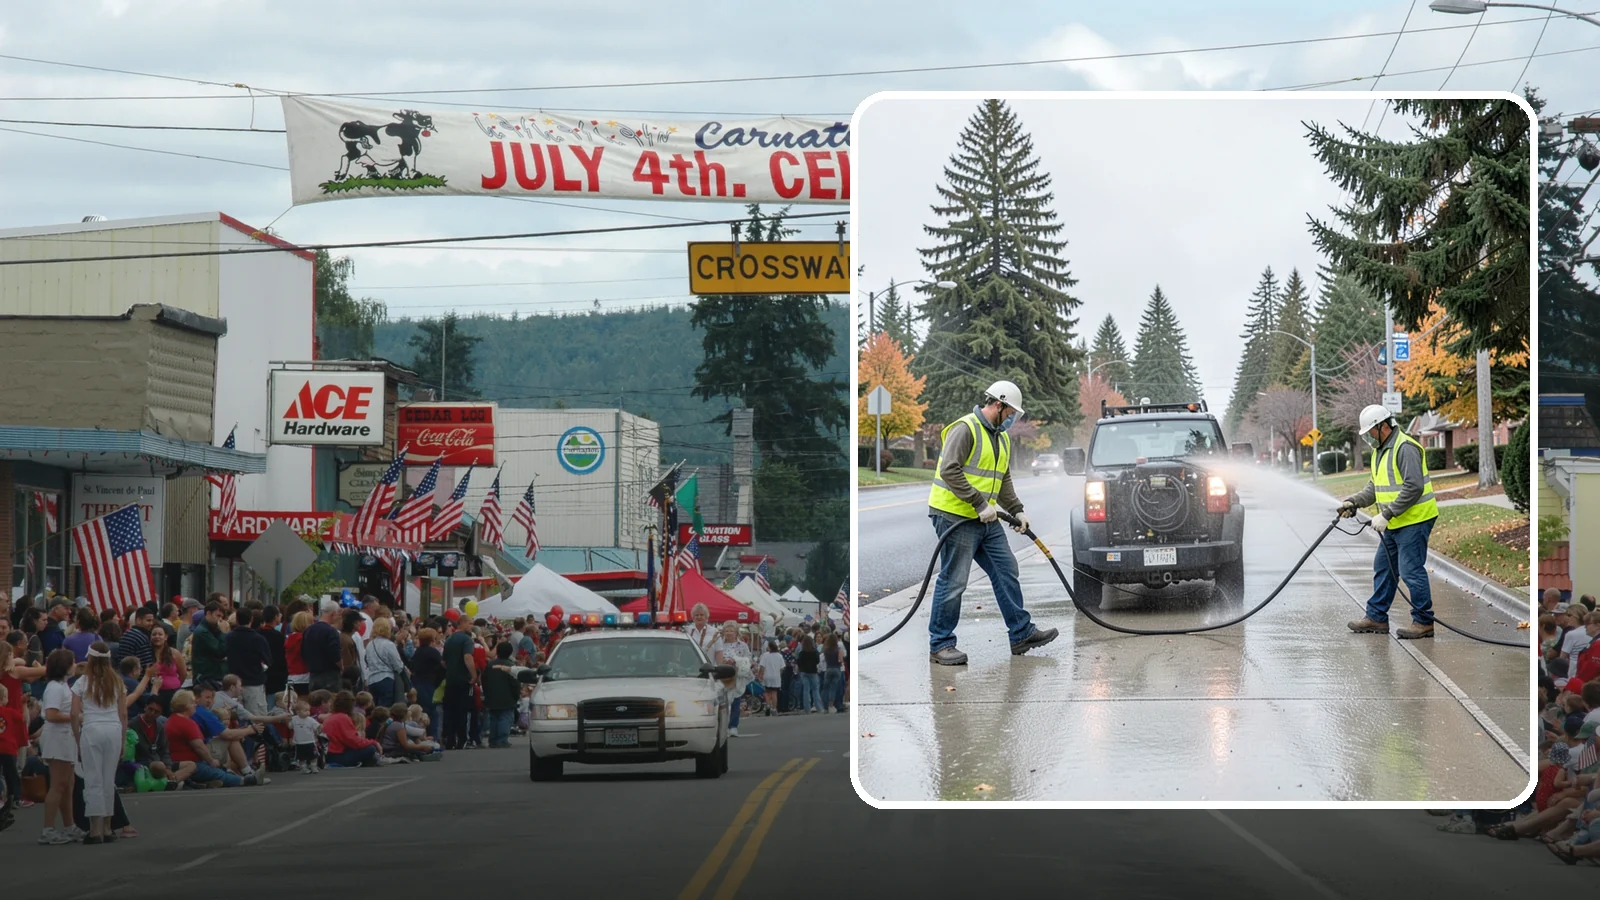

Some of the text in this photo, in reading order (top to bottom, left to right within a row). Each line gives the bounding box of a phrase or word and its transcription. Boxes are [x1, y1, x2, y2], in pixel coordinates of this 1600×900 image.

[481, 140, 605, 193] JULY
[632, 150, 747, 198] 4th.
[697, 254, 850, 280] CROSSWA
[282, 380, 373, 420] ACE
[406, 409, 485, 422] CEDAR LOG
[283, 421, 371, 436] Hardware
[416, 428, 476, 446] Coca-Cola
[353, 467, 385, 480] Simpl
[83, 484, 155, 495] St. Vincent de Paul
[213, 516, 330, 535] HARDARE
[688, 526, 741, 535] CRNATION
[699, 535, 730, 543] GLASS
